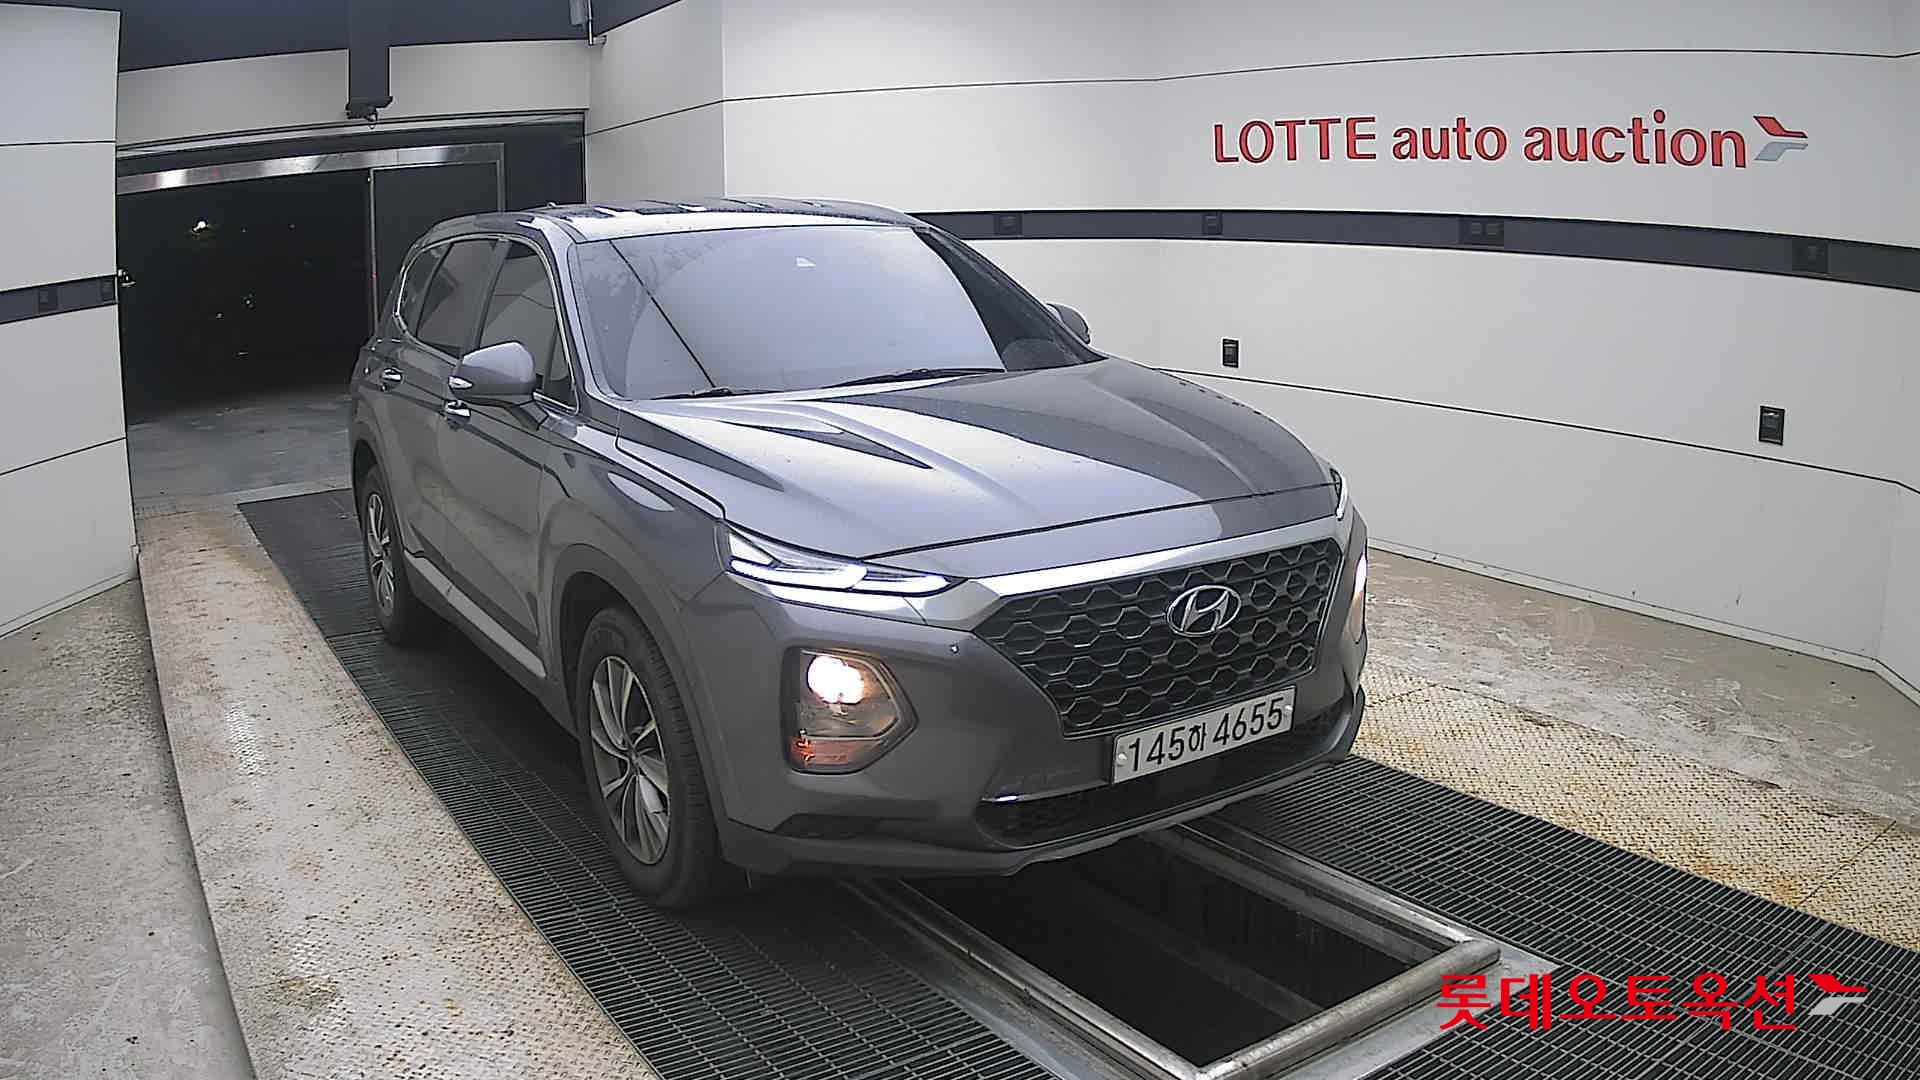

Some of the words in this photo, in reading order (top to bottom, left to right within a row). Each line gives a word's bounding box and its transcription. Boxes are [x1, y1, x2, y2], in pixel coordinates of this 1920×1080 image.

[1213, 117, 1377, 163] LOTTE
[1393, 118, 1508, 161] auto
[1524, 110, 1747, 168] auction
[1129, 722, 1206, 772] 145하
[1212, 697, 1284, 746] 4655
